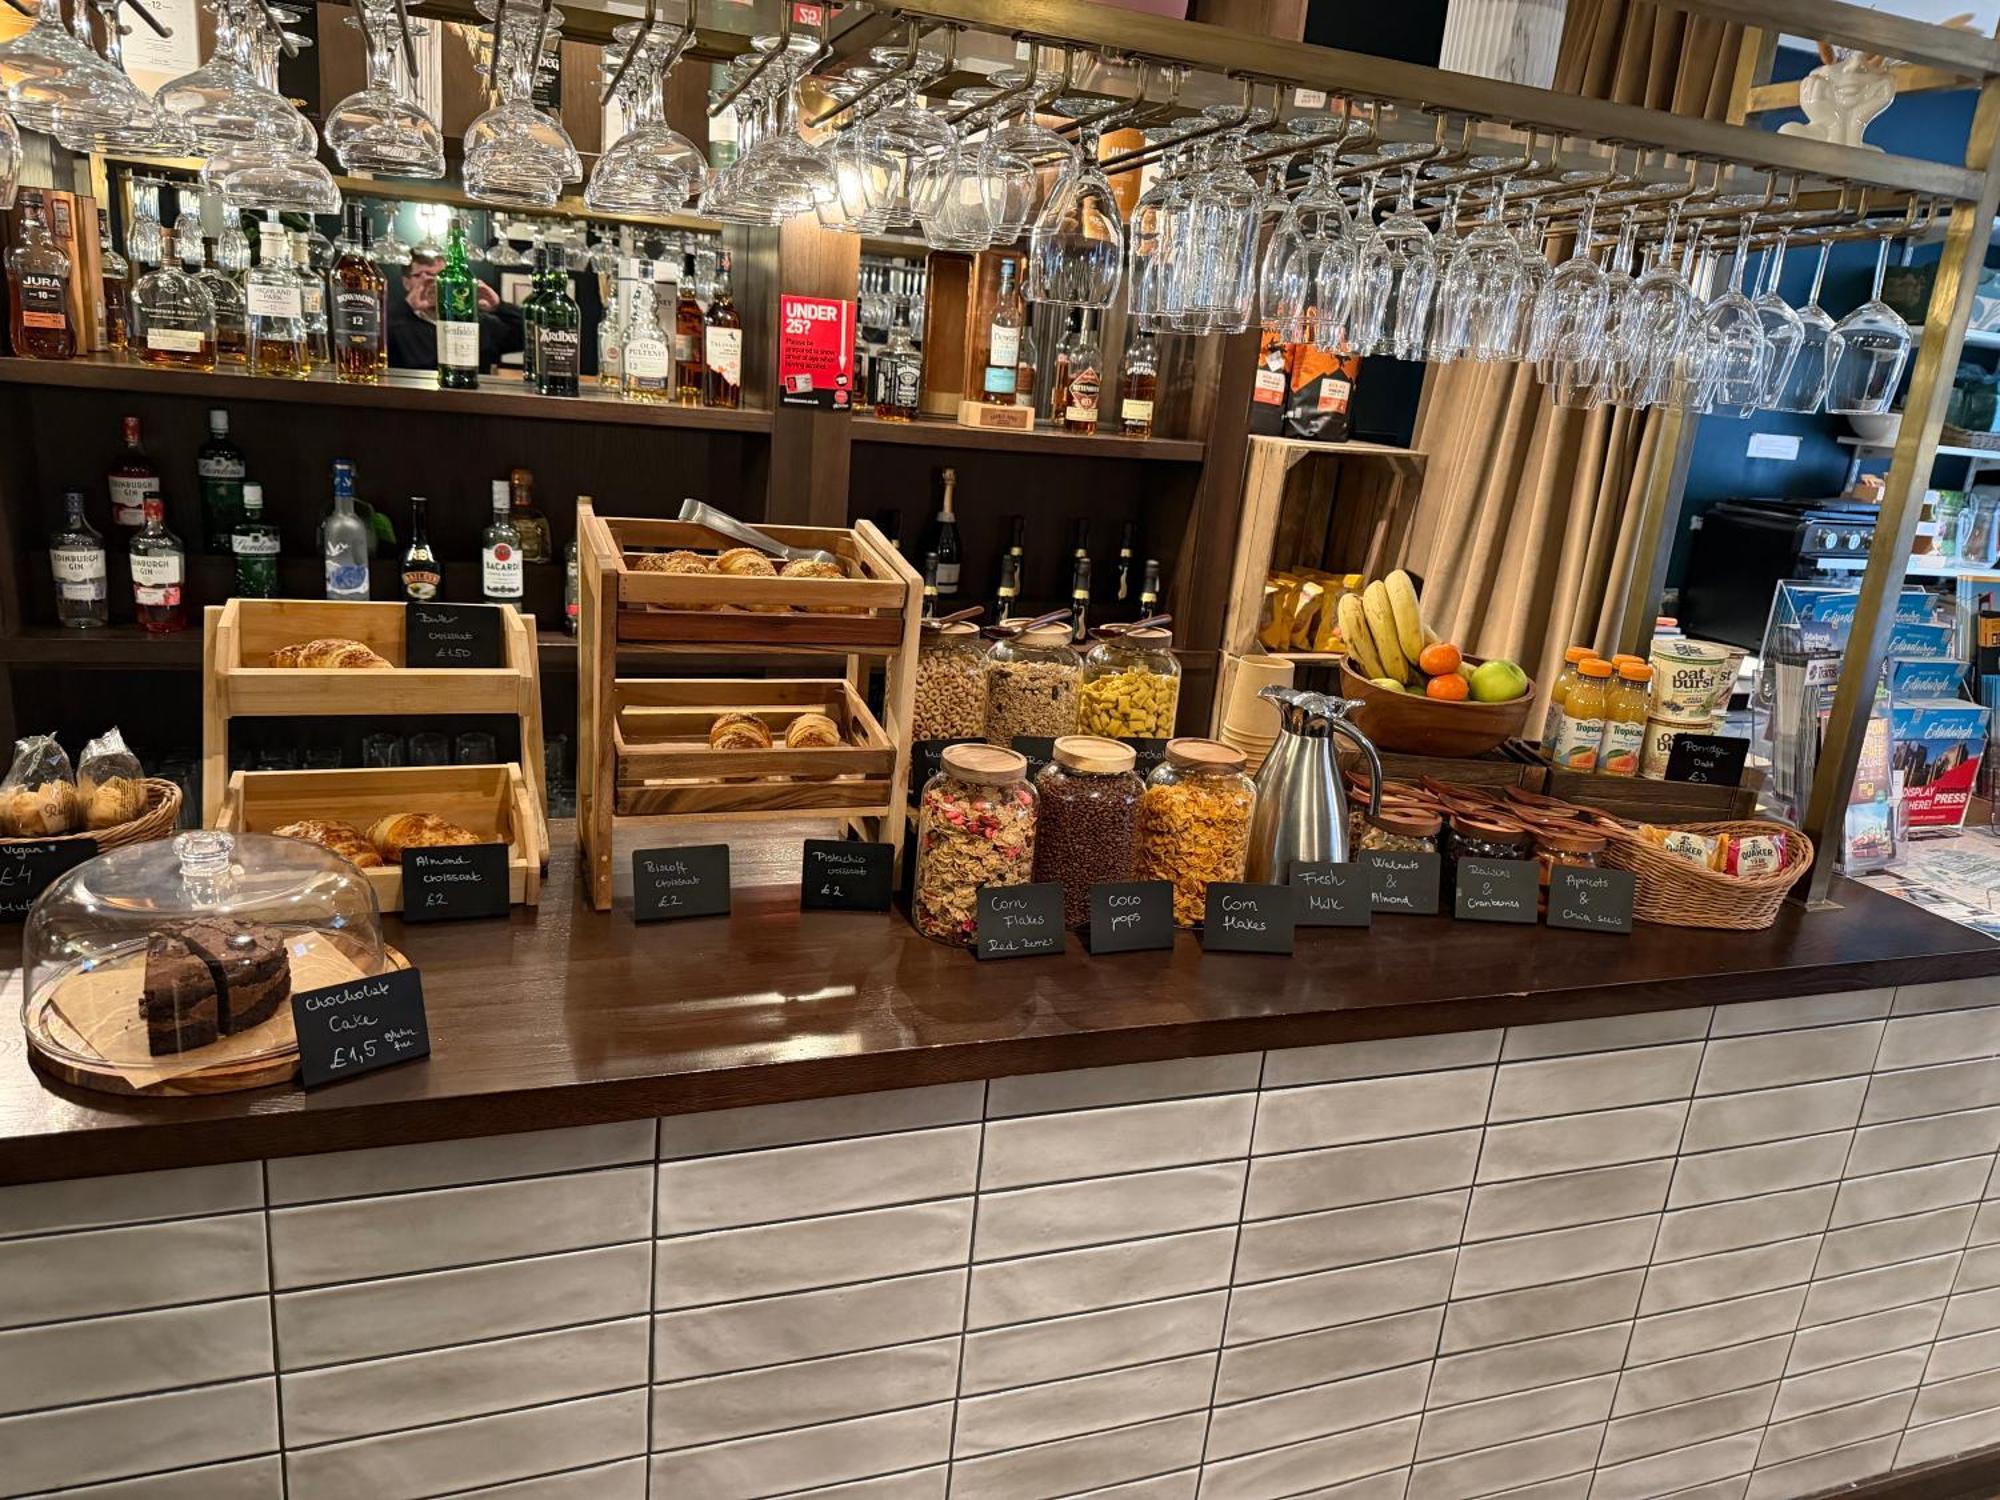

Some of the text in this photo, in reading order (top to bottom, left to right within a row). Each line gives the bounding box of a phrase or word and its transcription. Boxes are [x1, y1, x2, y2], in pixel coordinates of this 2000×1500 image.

[22, 276, 61, 288] JURA
[38, 291, 48, 300] 10
[786, 302, 838, 321] UNDER
[352, 316, 363, 325] 12
[786, 319, 811, 335] 25?
[124, 488, 138, 497] GIN
[53, 553, 98, 562] EDINBURGH
[68, 563, 84, 571] GIN
[139, 568, 154, 576] GIN
[486, 561, 520, 570] BACARDI
[1677, 667, 1706, 680] oat
[1672, 675, 1714, 689] burst
[1902, 674, 1950, 694] Edinburgh
[1924, 721, 1974, 739] Edinburgh
[1689, 771, 1708, 782] £3
[1903, 786, 1936, 797] DISPLAY
[1909, 799, 1932, 810] HERE!
[1934, 793, 1967, 804] PRESS
[2, 845, 43, 859] Vegan
[811, 851, 867, 864] Pistachio
[1741, 848, 1773, 860] QUAKER
[415, 856, 472, 867] Almond
[0, 864, 32, 886] £4
[423, 870, 483, 883] croissant
[1298, 870, 1346, 886] Fresh
[1386, 873, 1397, 889] &
[1565, 874, 1609, 889] Apricots
[821, 884, 844, 897] £2
[1482, 882, 1493, 895] &
[425, 892, 449, 907] £2
[658, 895, 683, 907] £2
[991, 896, 1028, 912] Corn
[1222, 895, 1258, 912] Corn
[1310, 895, 1345, 910] Milk
[1371, 891, 1414, 908] Almond
[1467, 897, 1520, 909] Cranberries
[1579, 891, 1589, 905] &
[1002, 914, 1045, 929] Flakes
[1562, 908, 1592, 923] Chia
[1111, 912, 1141, 933] pops
[988, 939, 1019, 952] Red
[328, 1014, 379, 1032] Cake
[330, 1039, 378, 1070] £1,5
